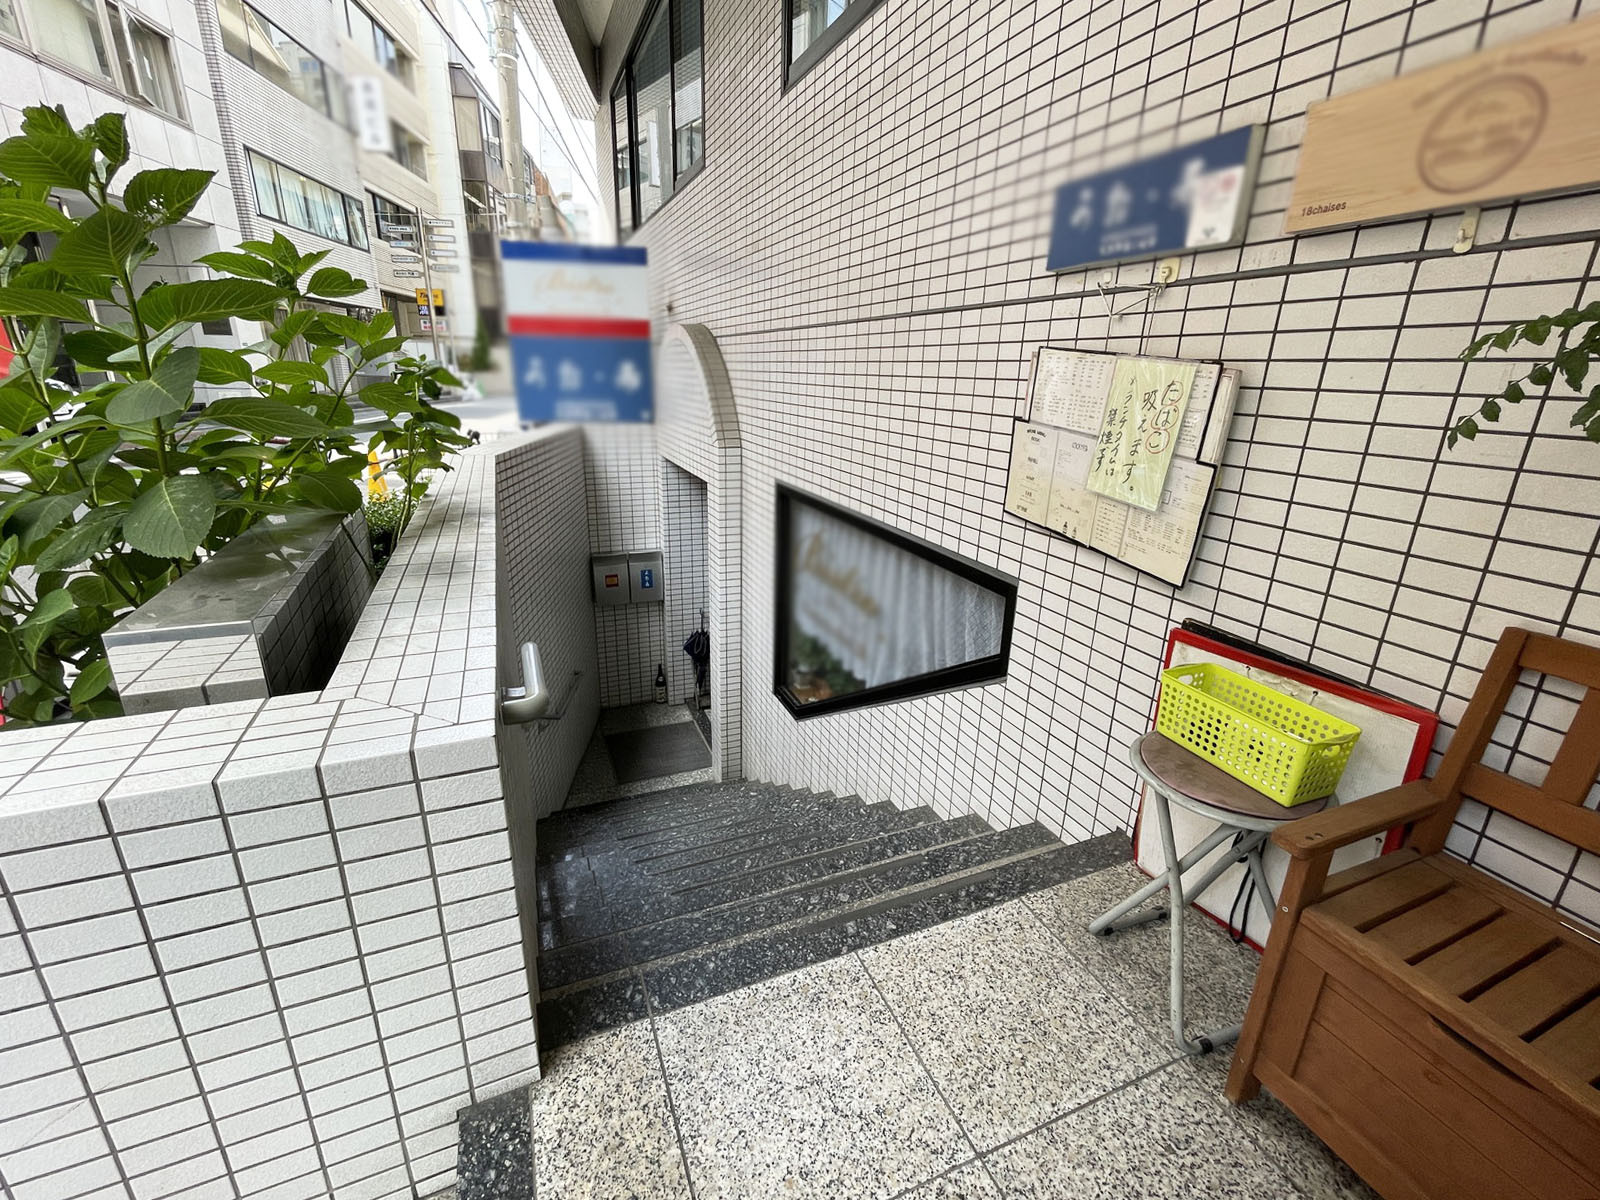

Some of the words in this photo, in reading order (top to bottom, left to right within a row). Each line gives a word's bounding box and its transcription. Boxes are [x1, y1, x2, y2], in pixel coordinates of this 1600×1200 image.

[1094, 408, 1118, 472] 禁煙です
[1148, 379, 1180, 450] たばこ
